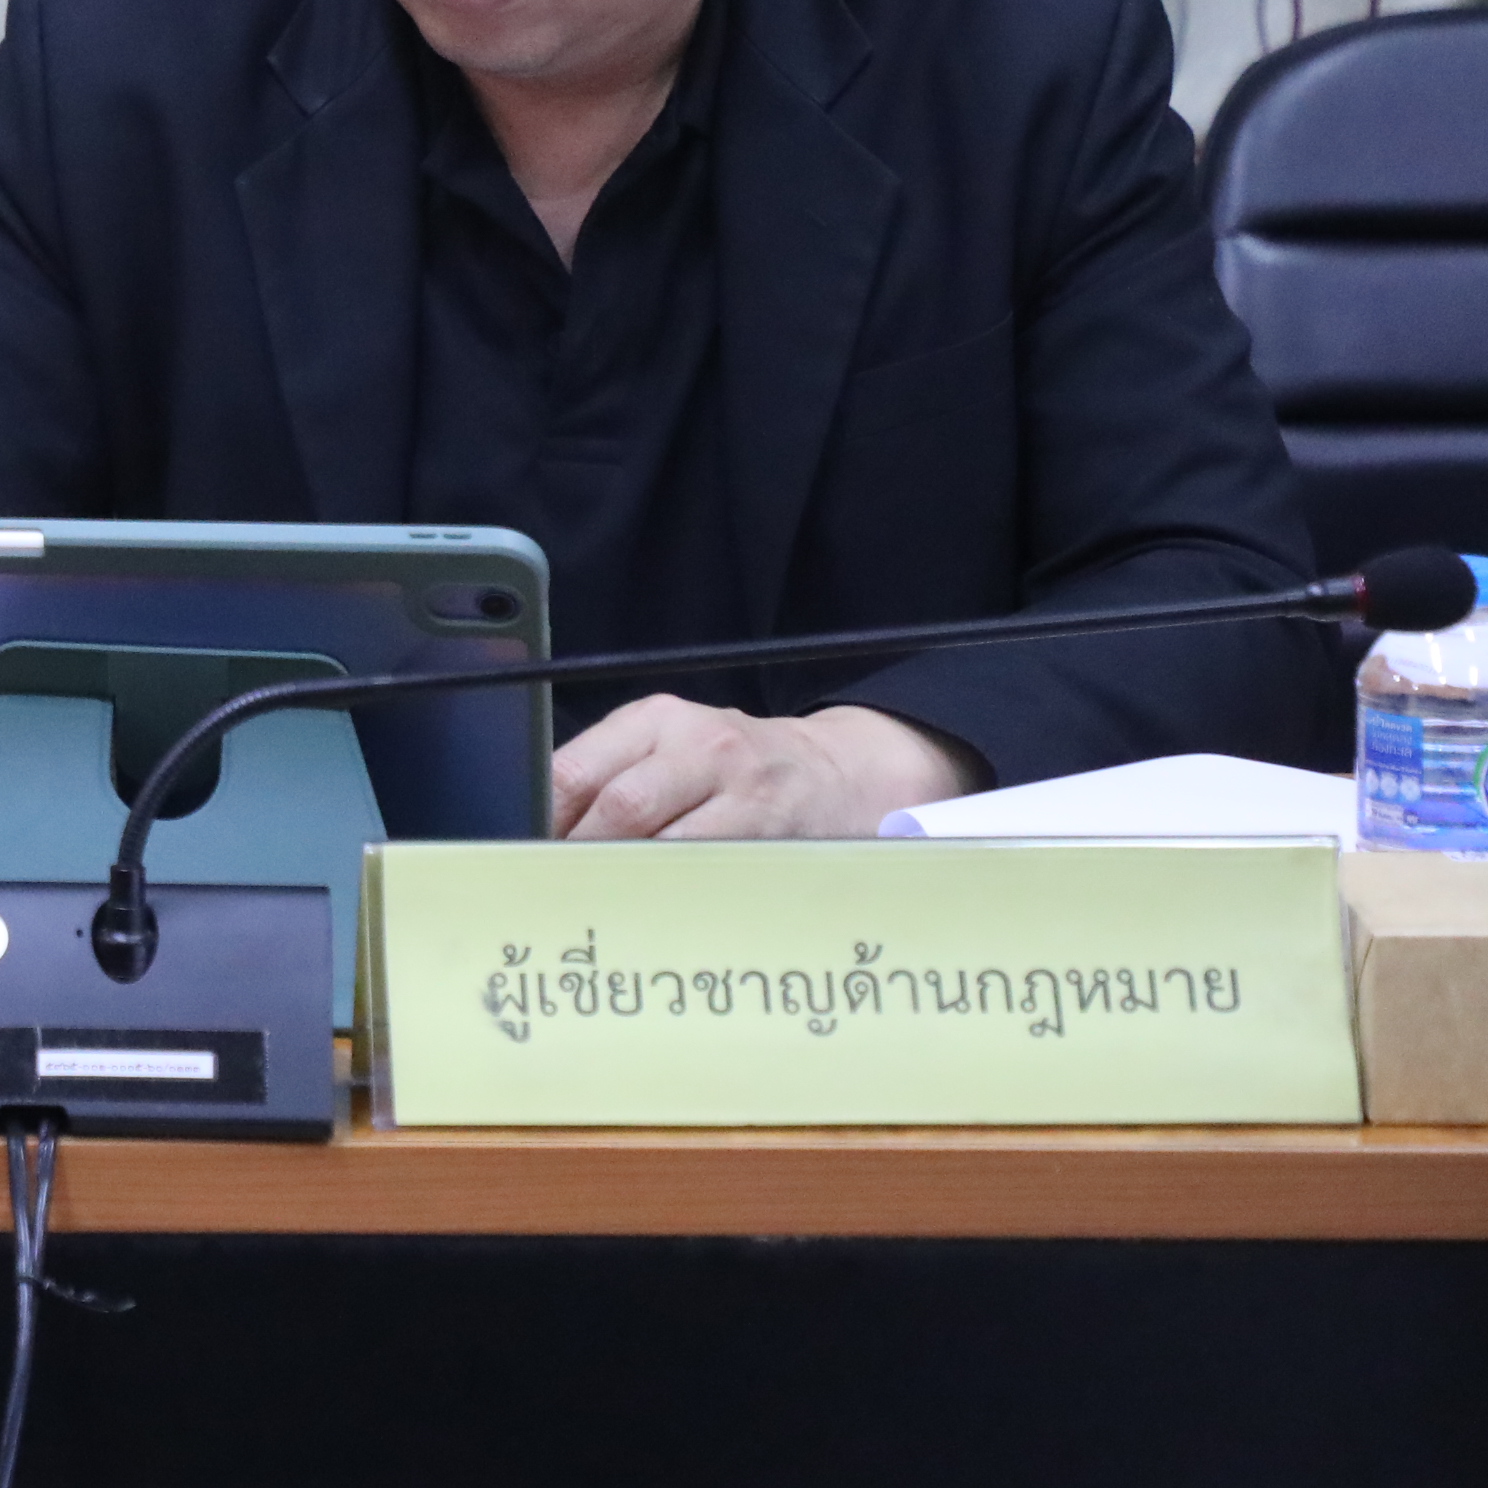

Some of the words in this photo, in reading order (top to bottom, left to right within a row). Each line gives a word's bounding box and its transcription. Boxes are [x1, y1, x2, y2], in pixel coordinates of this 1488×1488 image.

[482, 928, 1242, 1043] ผู้เชี่ยวชาญด้านกฎหมาย
